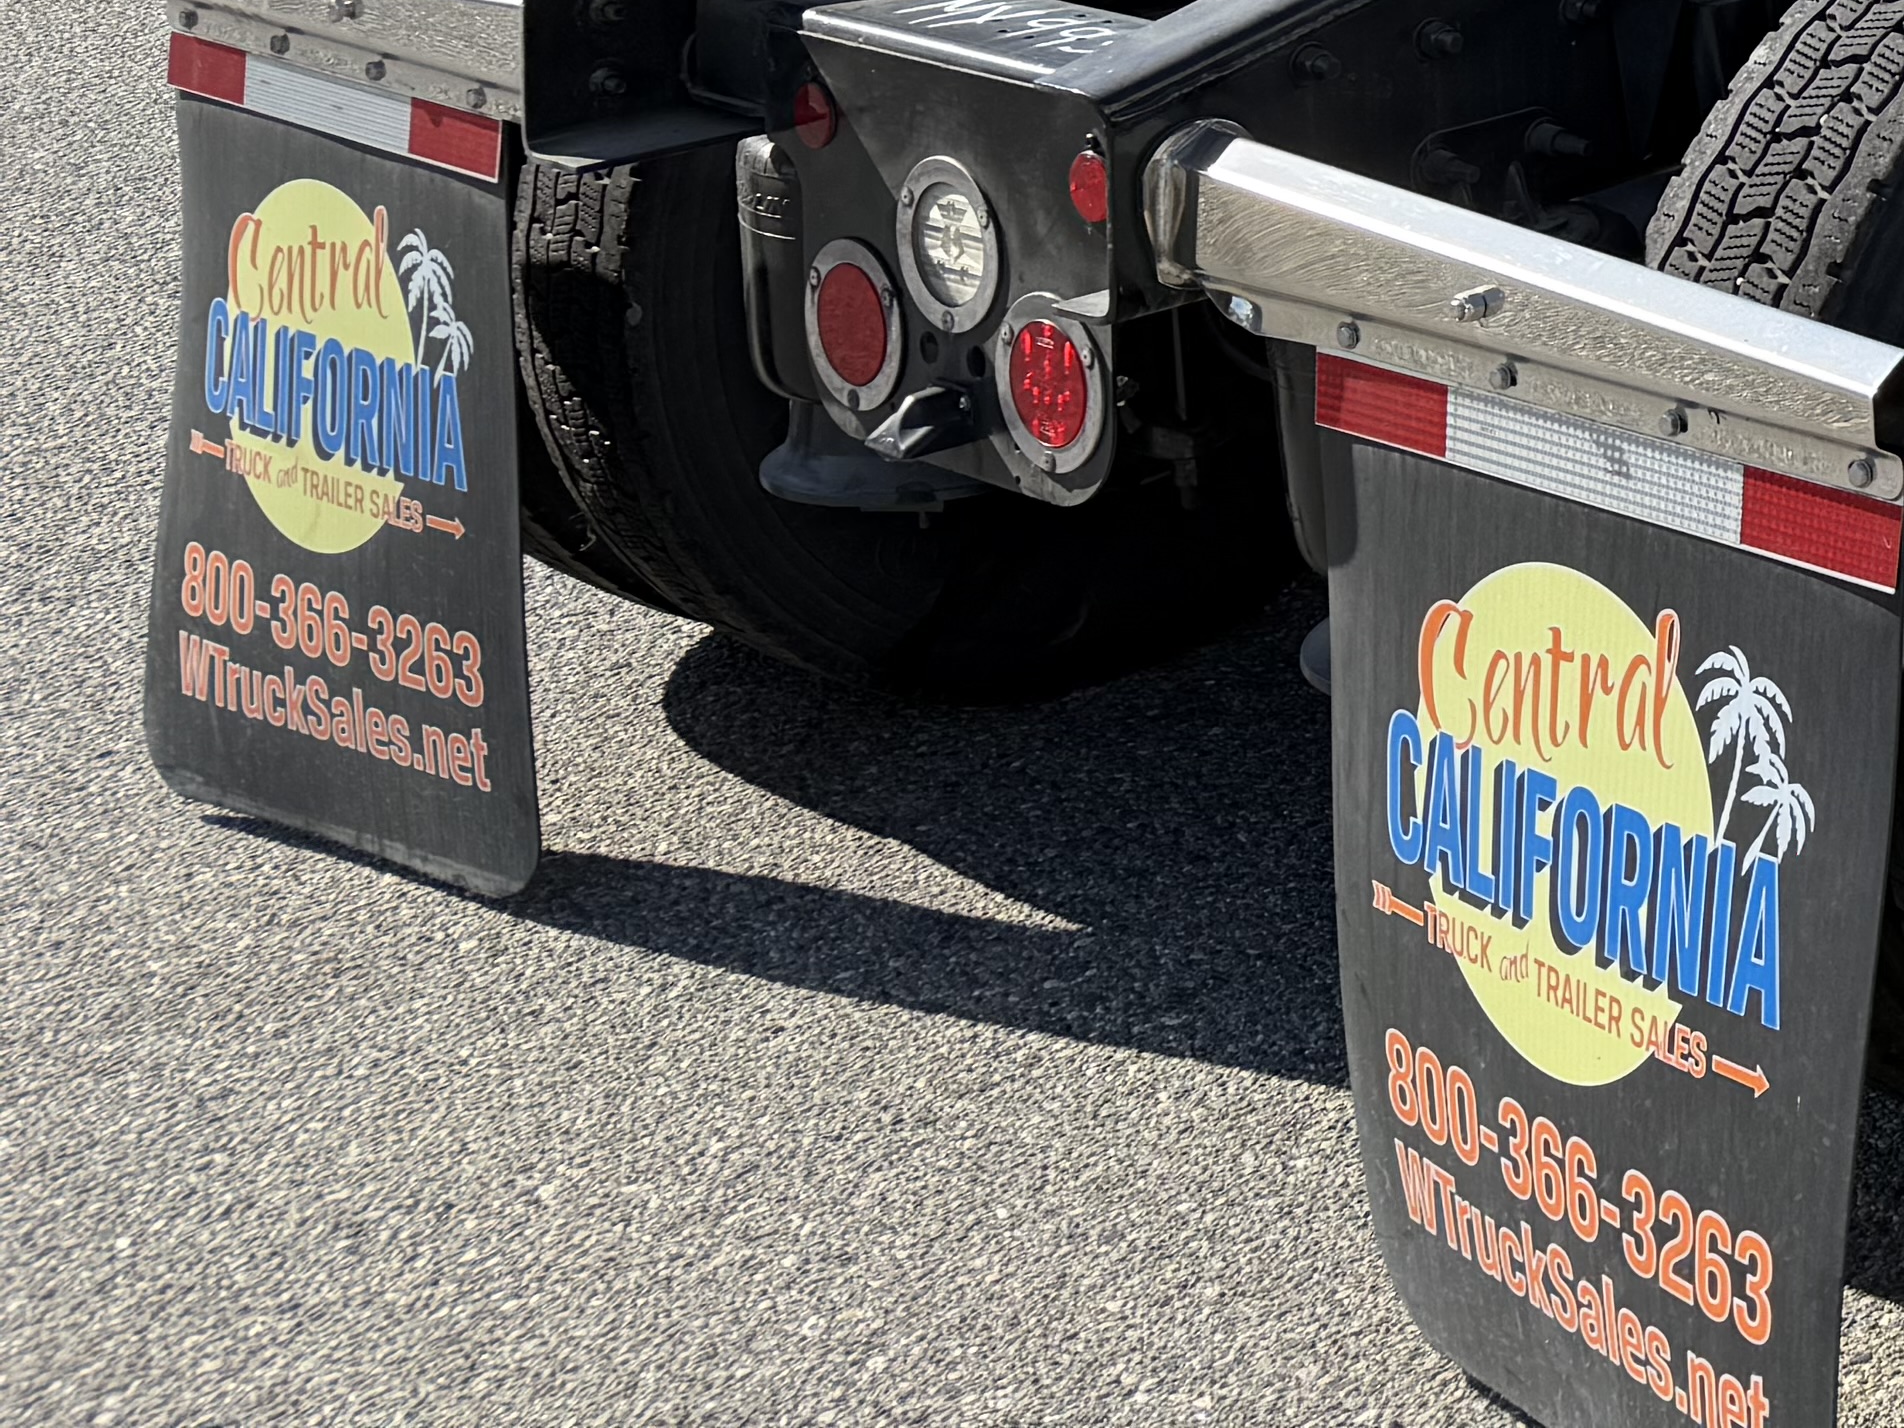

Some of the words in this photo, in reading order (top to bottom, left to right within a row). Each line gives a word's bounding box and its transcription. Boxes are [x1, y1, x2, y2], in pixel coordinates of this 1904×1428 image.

[228, 204, 390, 324] Central
[204, 297, 469, 493] CALIFORNIA
[224, 438, 272, 484] TRUCK
[276, 455, 299, 489] and
[300, 466, 365, 515] TRAILER
[369, 489, 424, 533] SALES
[178, 629, 492, 792] WTruckSales.net
[181, 541, 485, 708] 800-366-3263
[1418, 598, 1682, 771] Central
[1386, 707, 1782, 1032] CALIFORNIA
[1423, 901, 1493, 973] TRUCK
[1499, 939, 1530, 984] and
[1533, 957, 1622, 1039] TRAILER
[1629, 1006, 1709, 1080] SALES
[1385, 1027, 1775, 1346] 800-366-3263
[1393, 1137, 1771, 1428] WTruckSales.net
